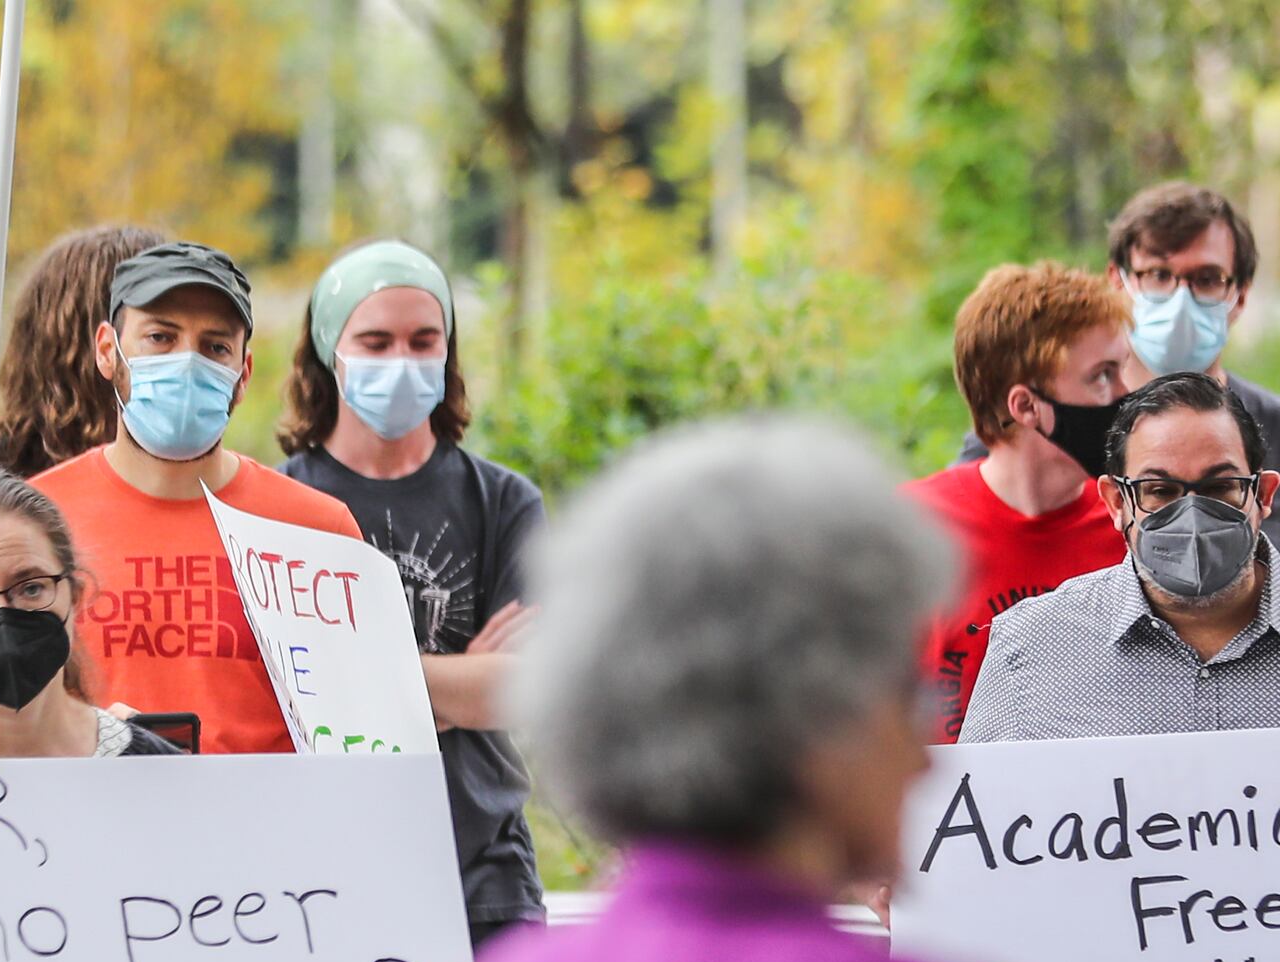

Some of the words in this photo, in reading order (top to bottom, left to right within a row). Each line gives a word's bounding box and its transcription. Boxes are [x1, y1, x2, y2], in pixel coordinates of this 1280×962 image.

[125, 555, 212, 588] THE
[74, 588, 212, 624] ORTH
[102, 624, 213, 658] FACE
